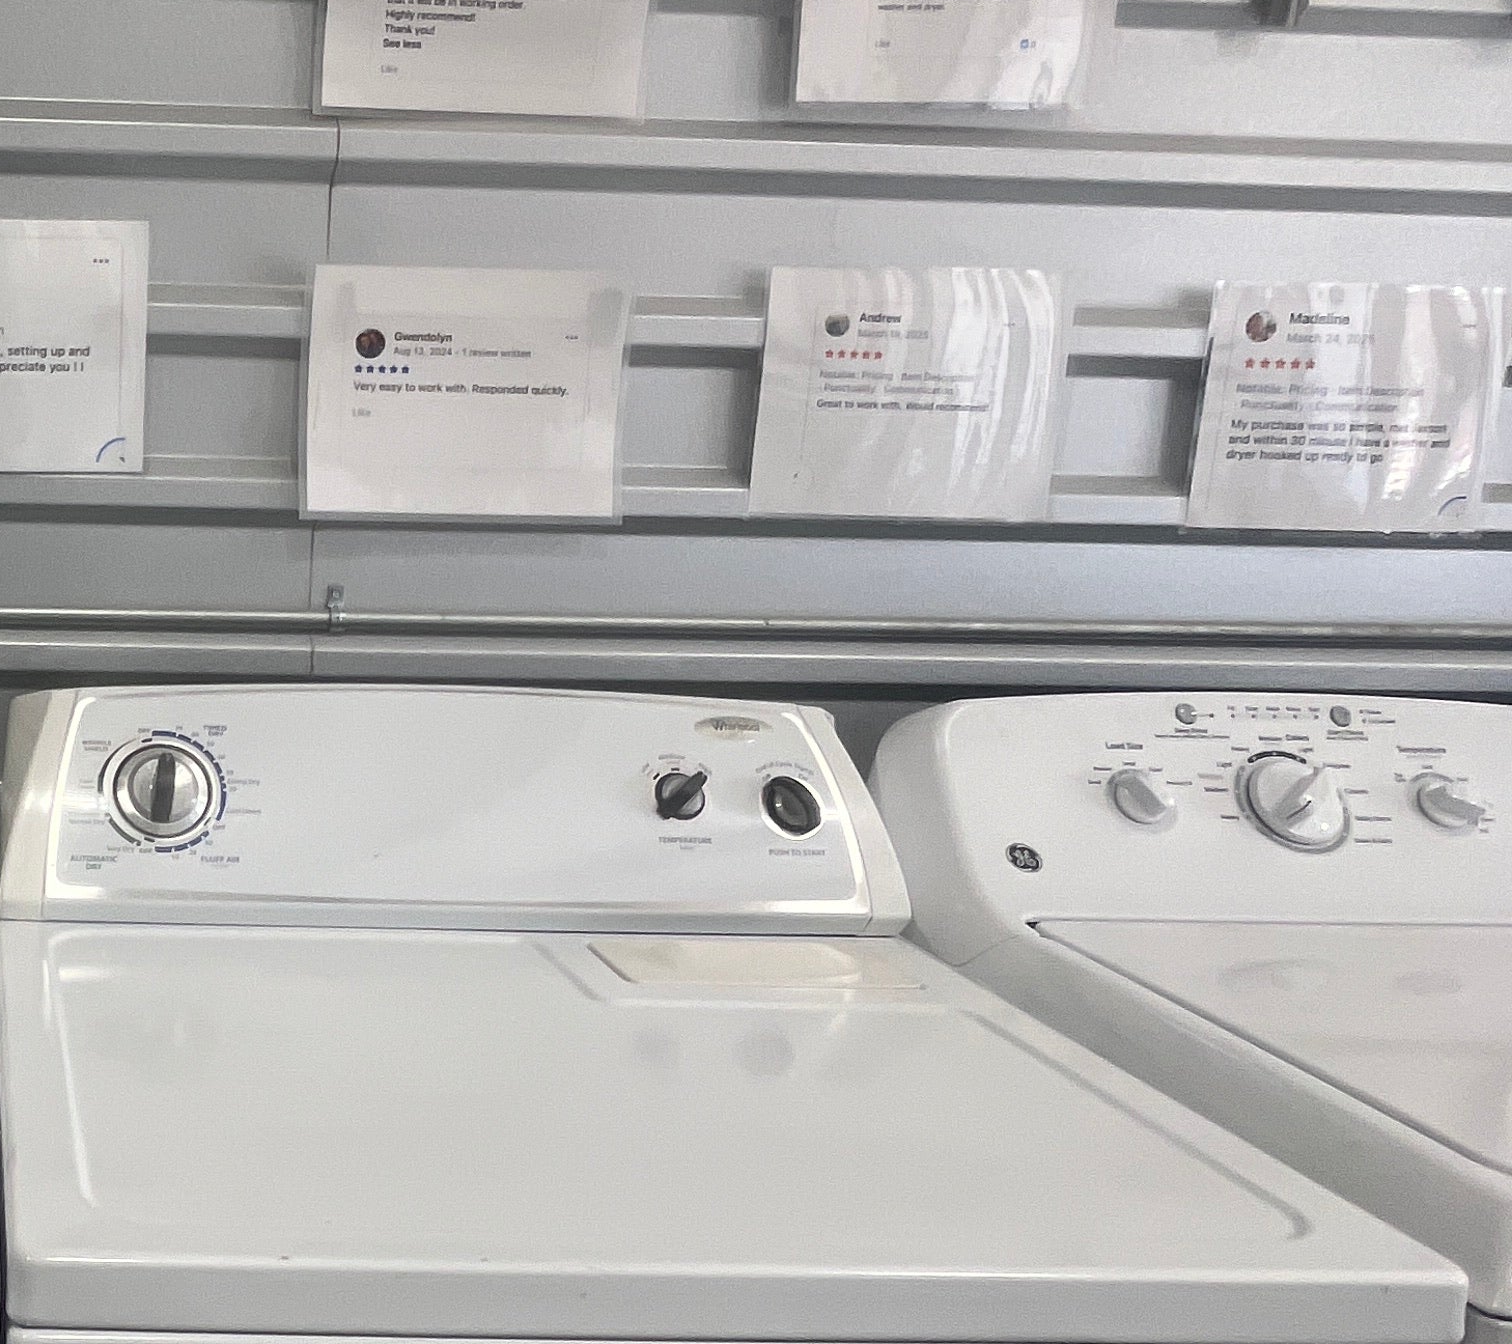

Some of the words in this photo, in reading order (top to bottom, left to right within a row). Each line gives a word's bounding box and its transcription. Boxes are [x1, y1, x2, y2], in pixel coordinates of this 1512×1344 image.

[386, 10, 415, 21] Highly
[385, 24, 412, 34] Thank
[859, 313, 901, 323] Andrew
[7, 346, 47, 359] setting
[51, 348, 65, 359] up
[68, 346, 90, 357] and
[50, 364, 70, 374] you
[353, 382, 376, 394] Very
[379, 384, 402, 394] easy
[405, 383, 416, 392] to
[418, 383, 442, 393] work
[472, 385, 528, 396] Responded
